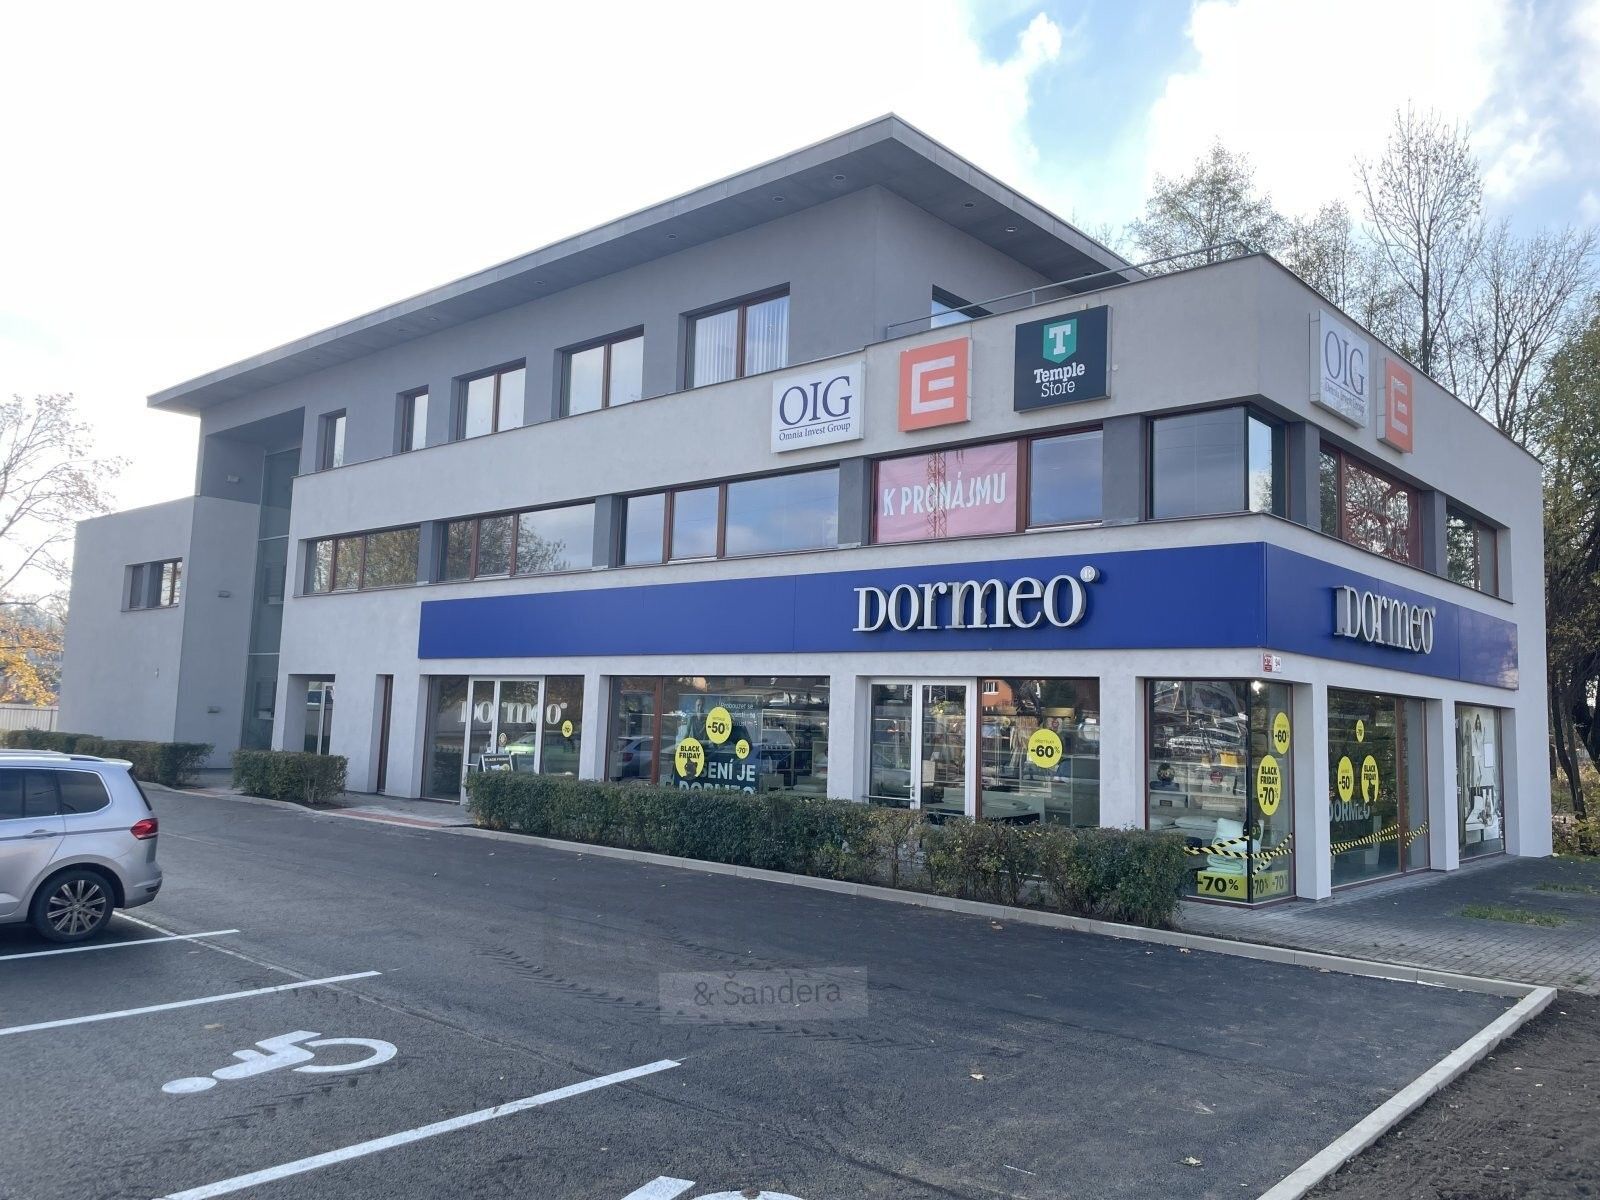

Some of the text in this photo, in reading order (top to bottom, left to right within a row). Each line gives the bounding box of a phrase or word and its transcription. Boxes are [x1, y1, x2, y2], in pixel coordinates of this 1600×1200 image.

[1324, 330, 1365, 396] OIG
[1033, 360, 1086, 385] Temple
[1040, 379, 1076, 398] Store
[778, 374, 853, 427] OIG
[778, 420, 852, 442] Omnia Invest Group
[883, 472, 1007, 517] K PRONÁJMU
[679, 752, 701, 760] FRIDAY
[680, 745, 700, 753] BLACK
[1031, 745, 1060, 758] -60%
[736, 763, 756, 782] JE
[1261, 766, 1278, 776] BLACK
[1363, 764, 1376, 773] BLACK
[1363, 773, 1377, 781] FRIDAY
[1260, 775, 1278, 786] FRIDAY
[1259, 786, 1279, 806] -70%
[1195, 875, 1239, 893] -70%
